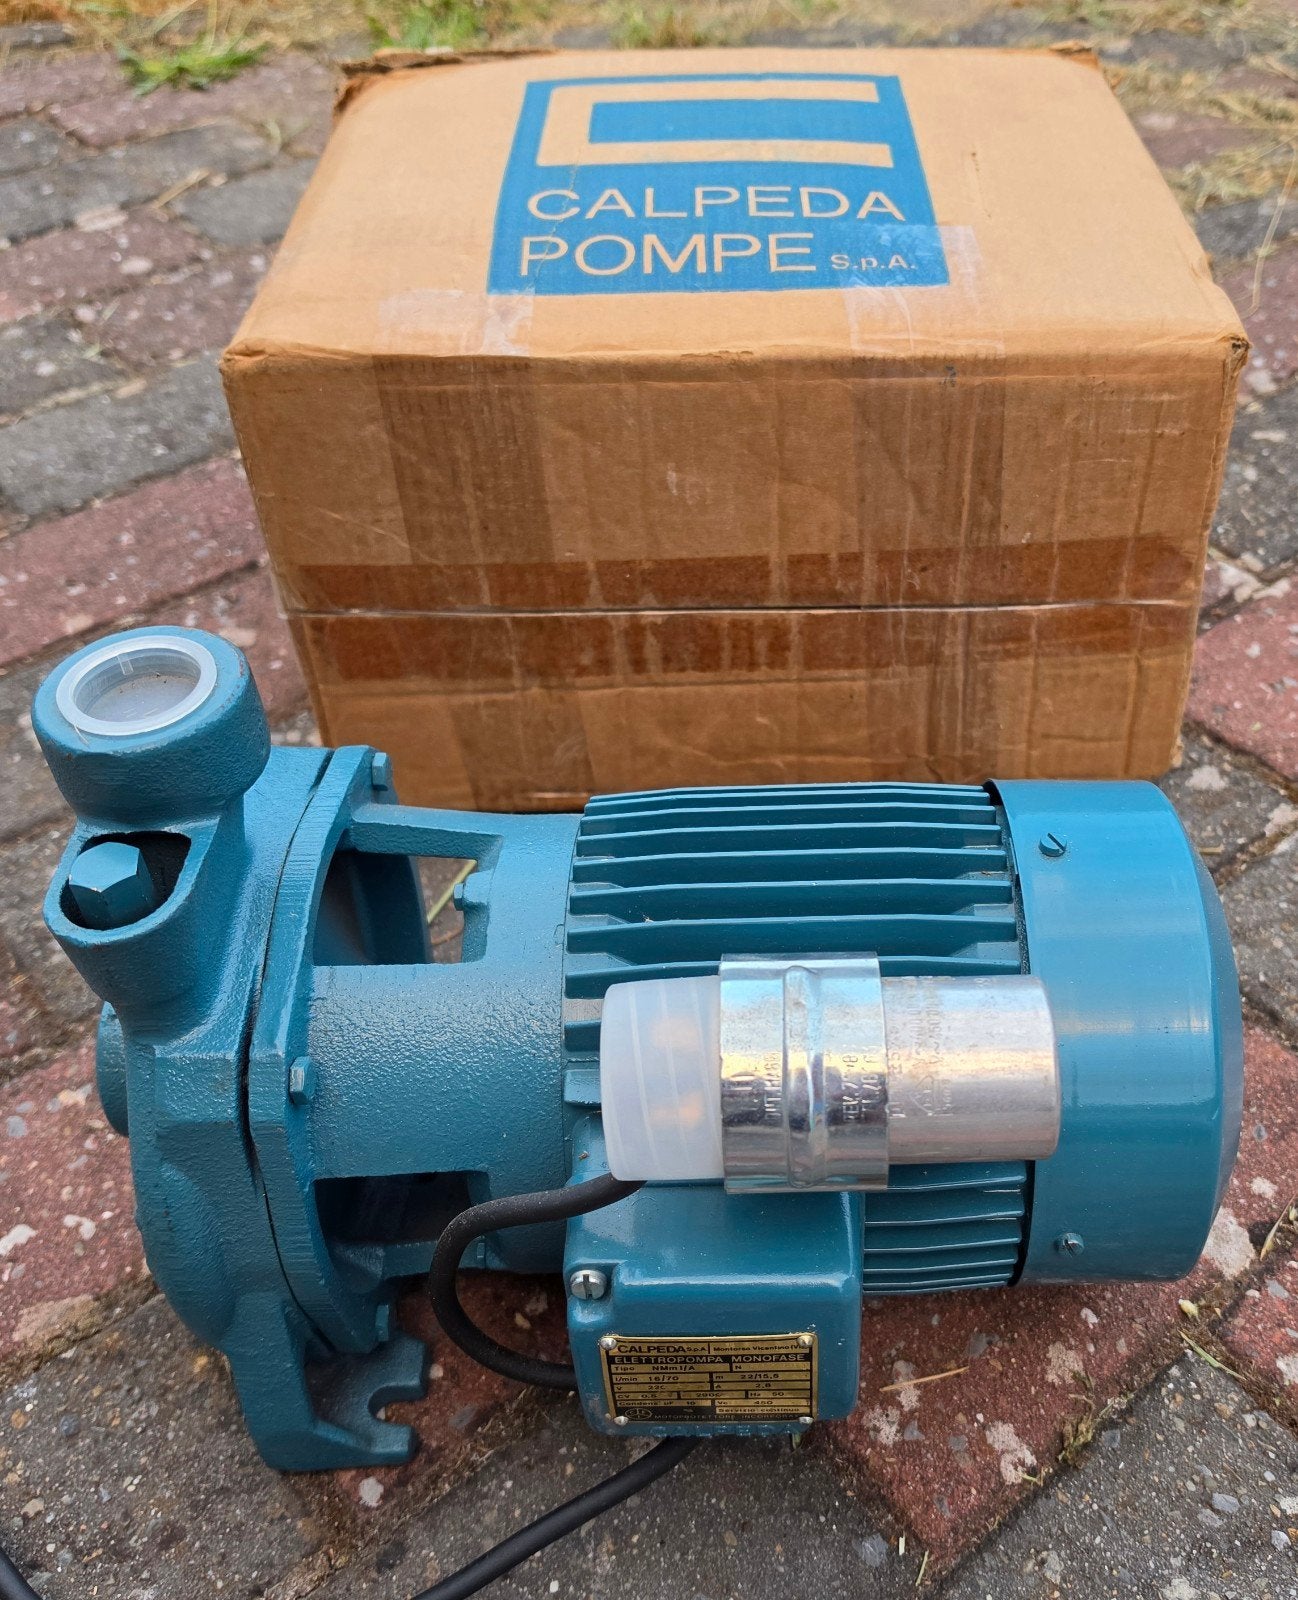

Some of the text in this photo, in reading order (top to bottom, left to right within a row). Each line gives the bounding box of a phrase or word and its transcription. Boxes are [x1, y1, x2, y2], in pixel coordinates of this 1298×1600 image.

[527, 186, 906, 222] CALPEDA
[520, 232, 917, 276] POMPE S.p.A.
[614, 1353, 805, 1364] ELETTROPOMPA MONOFASE
[617, 1344, 686, 1354] CALPEDA
